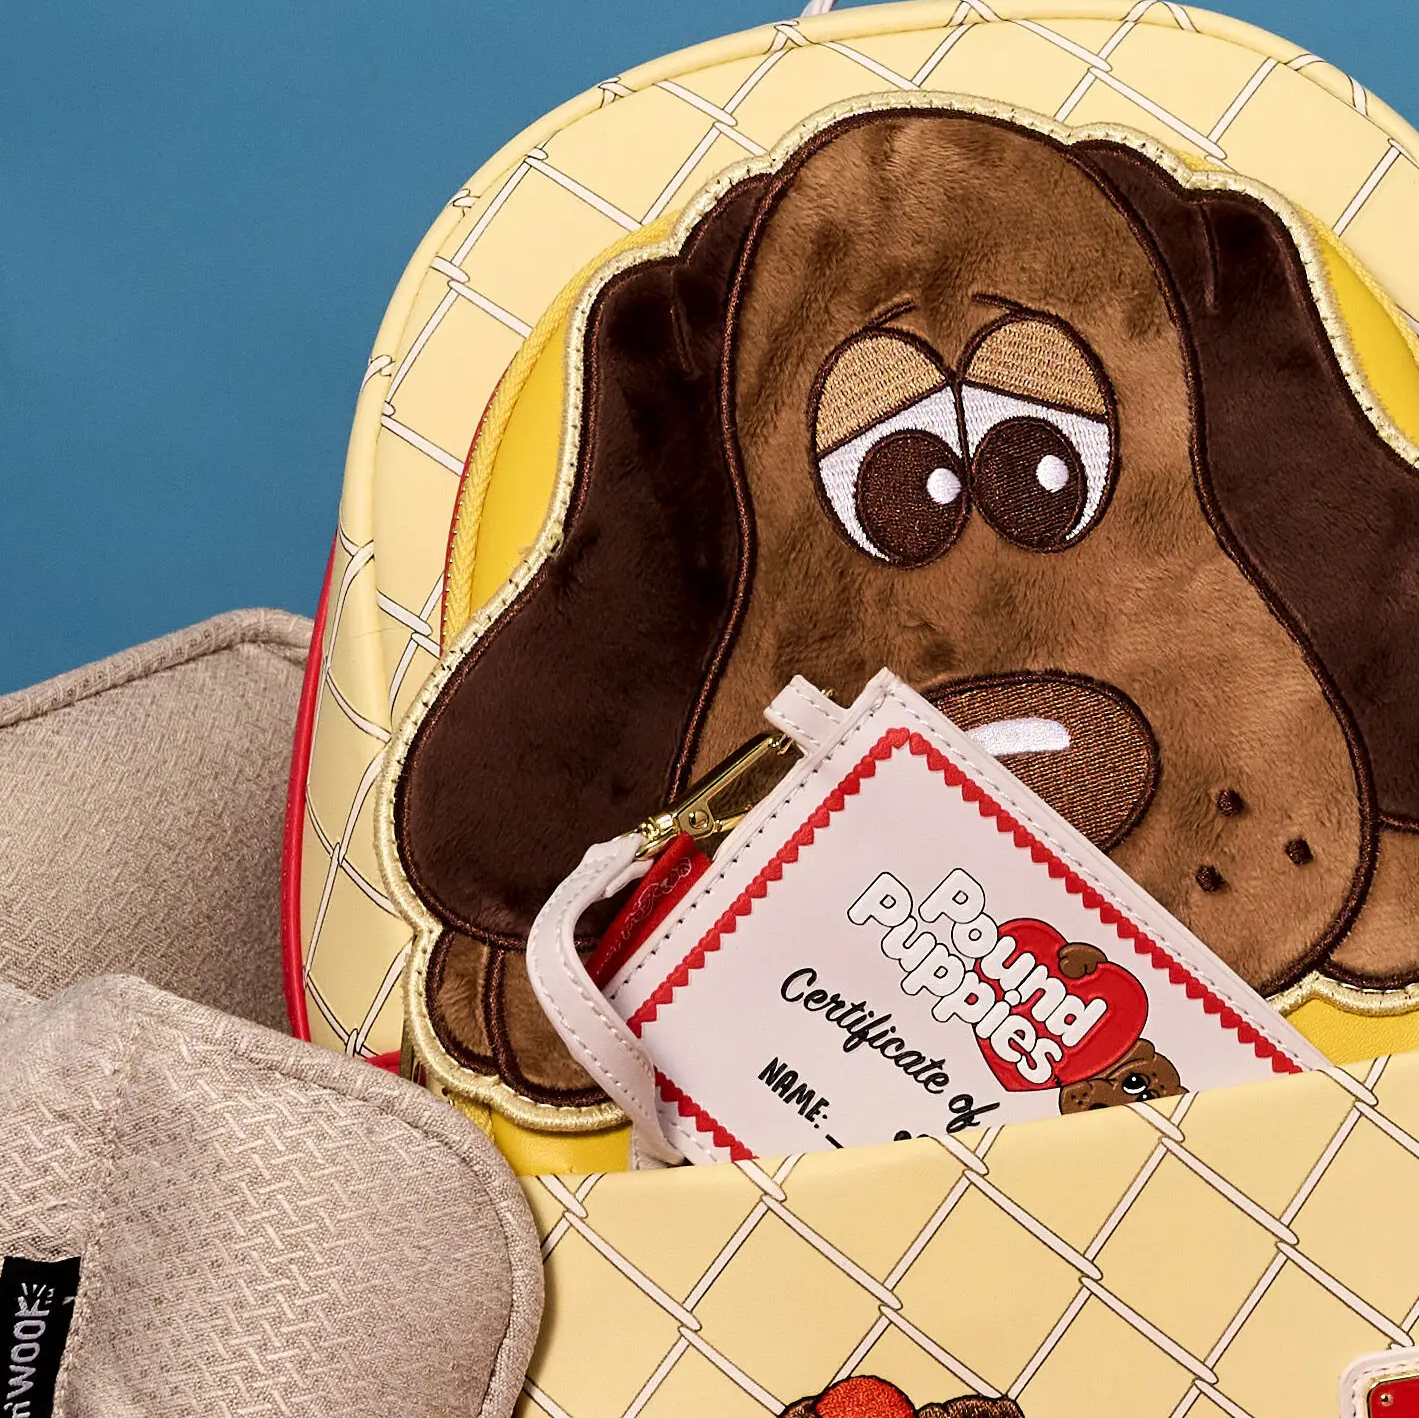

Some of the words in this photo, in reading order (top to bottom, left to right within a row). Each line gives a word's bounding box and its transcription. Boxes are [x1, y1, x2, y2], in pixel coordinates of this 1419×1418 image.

[847, 871, 1064, 1085] Puppies
[918, 867, 1108, 1048] Pound
[757, 1056, 830, 1129] NAME:
[780, 967, 950, 1095] Certificate
[946, 1093, 1000, 1134] of
